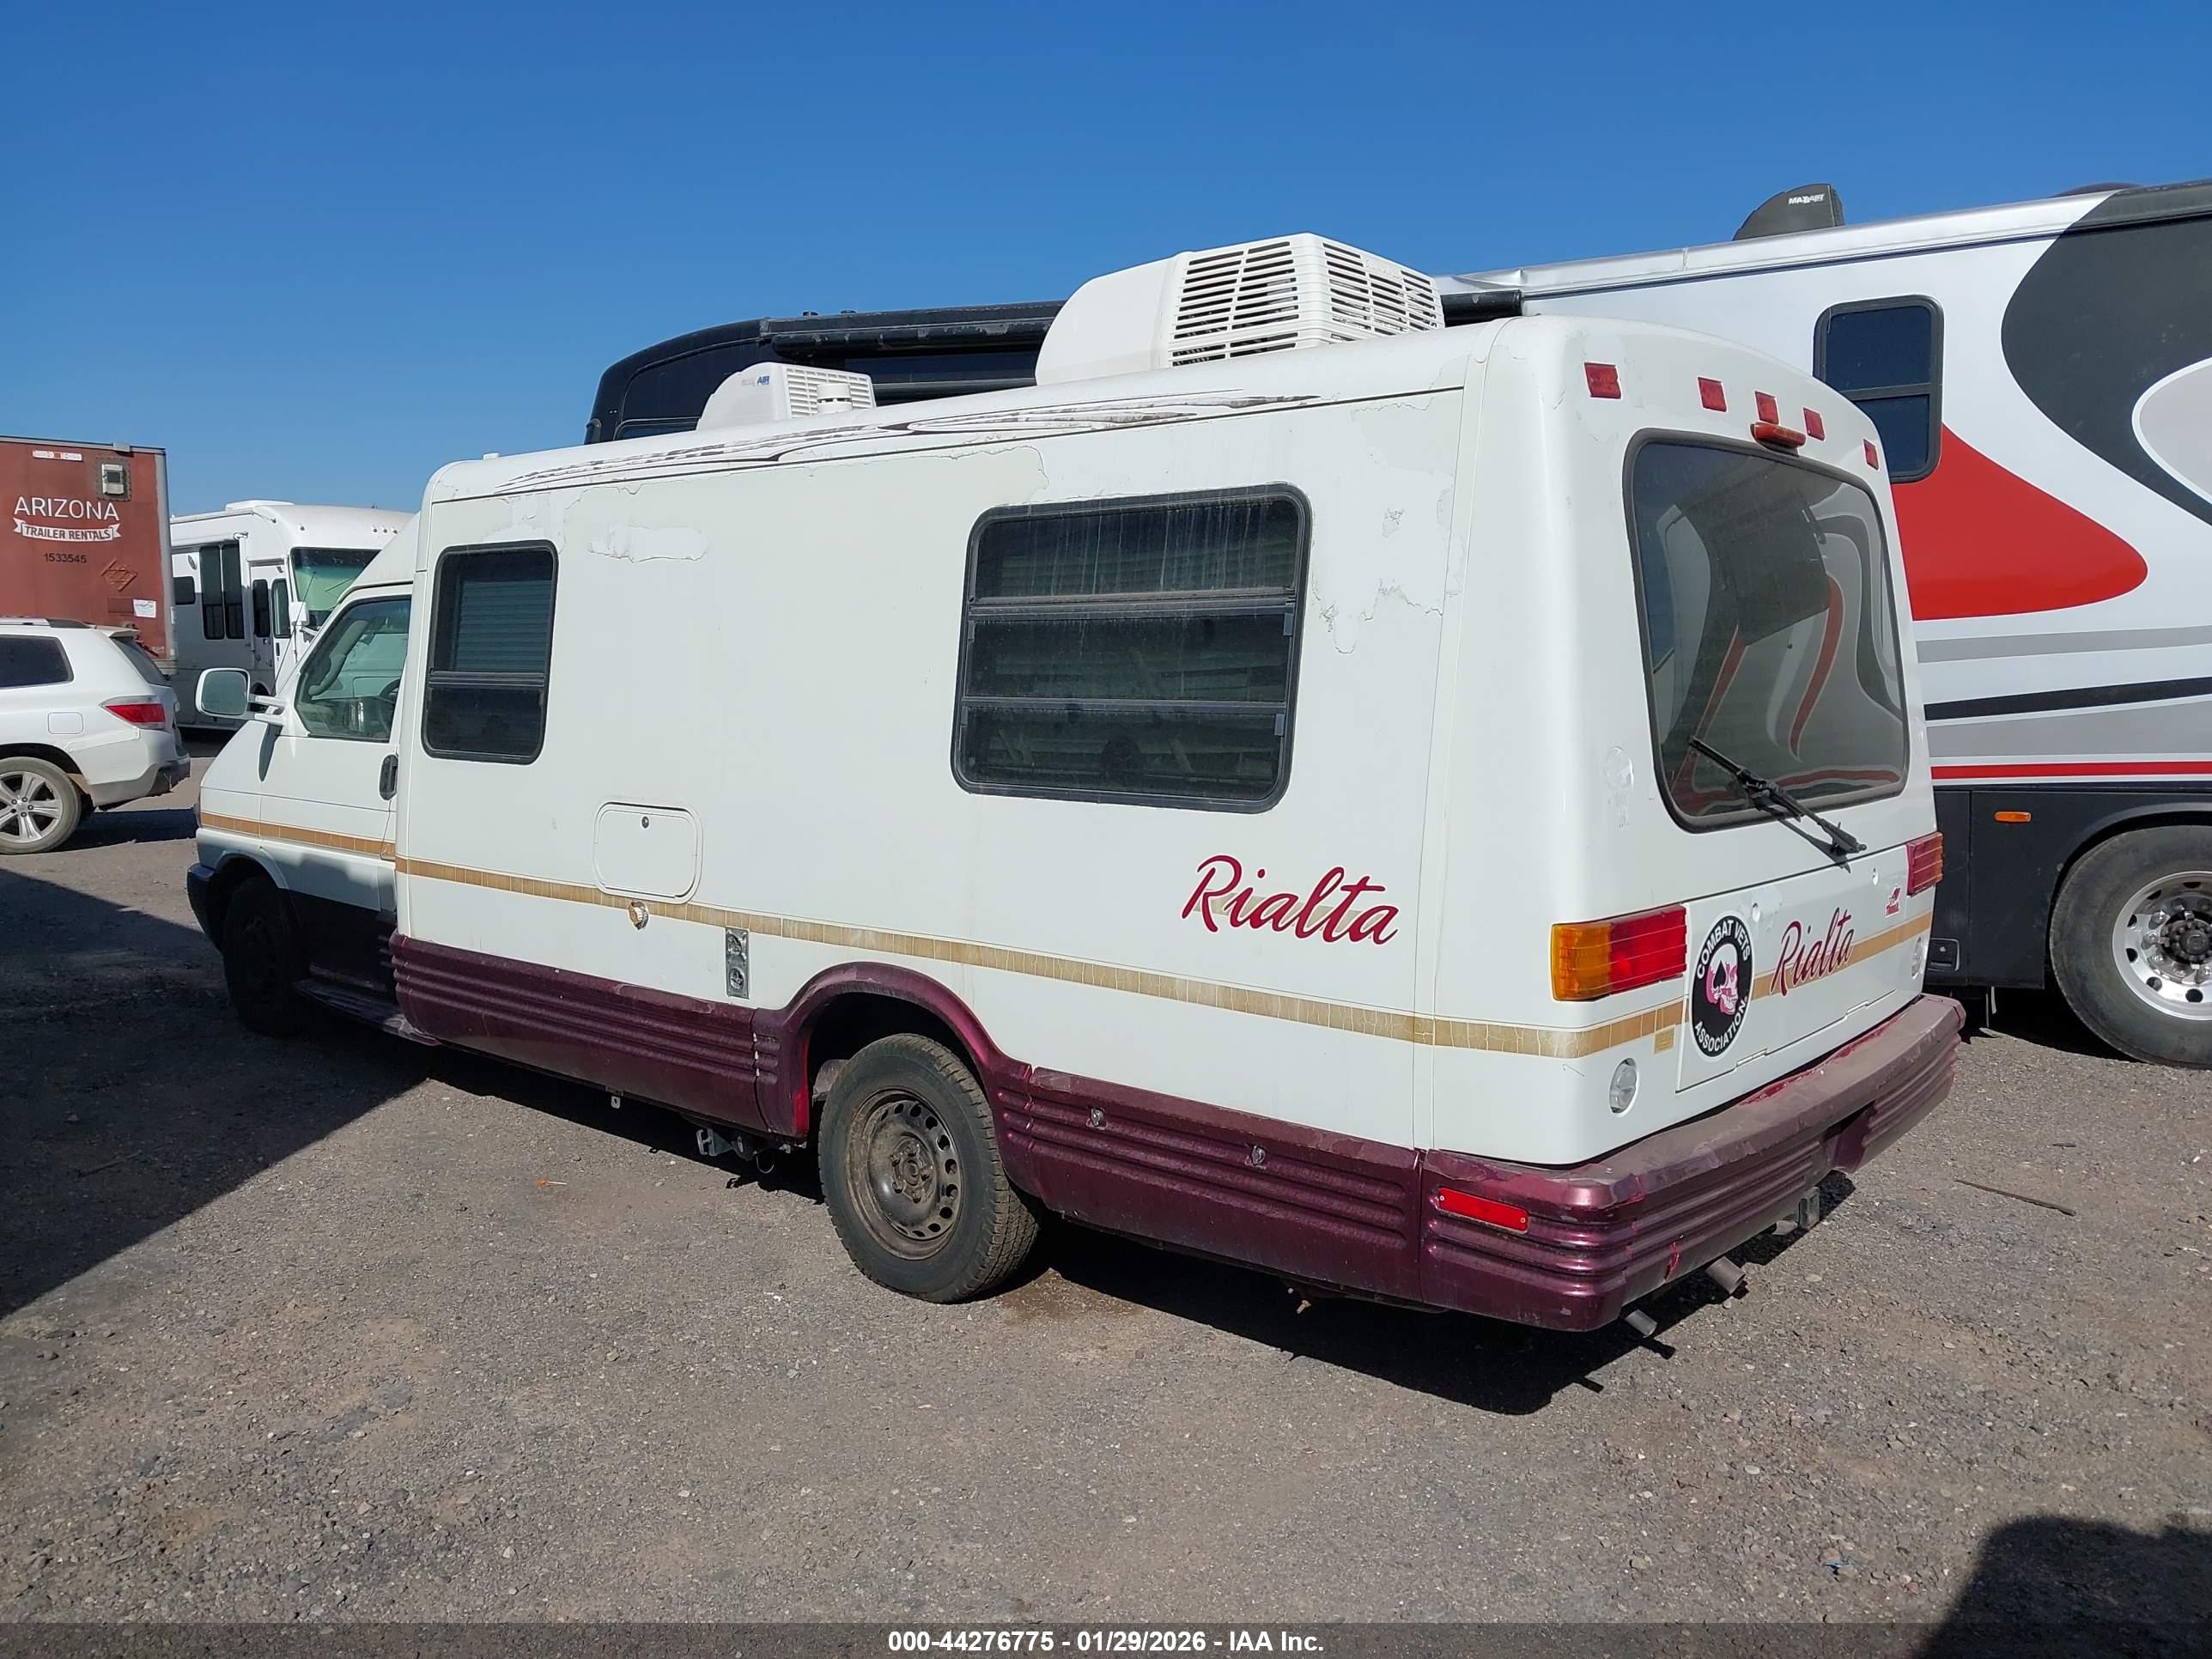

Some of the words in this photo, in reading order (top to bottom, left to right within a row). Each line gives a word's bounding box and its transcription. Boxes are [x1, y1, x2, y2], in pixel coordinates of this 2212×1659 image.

[14, 495, 120, 521] ARIZONA
[25, 525, 66, 540] TRAILER
[69, 527, 112, 541] RENTALS
[44, 552, 88, 564] 1533545
[1182, 854, 1400, 945] Rialta
[1696, 920, 1735, 980] COMBAT
[1734, 921, 1751, 962] VETS
[1770, 906, 1855, 996] Rialta
